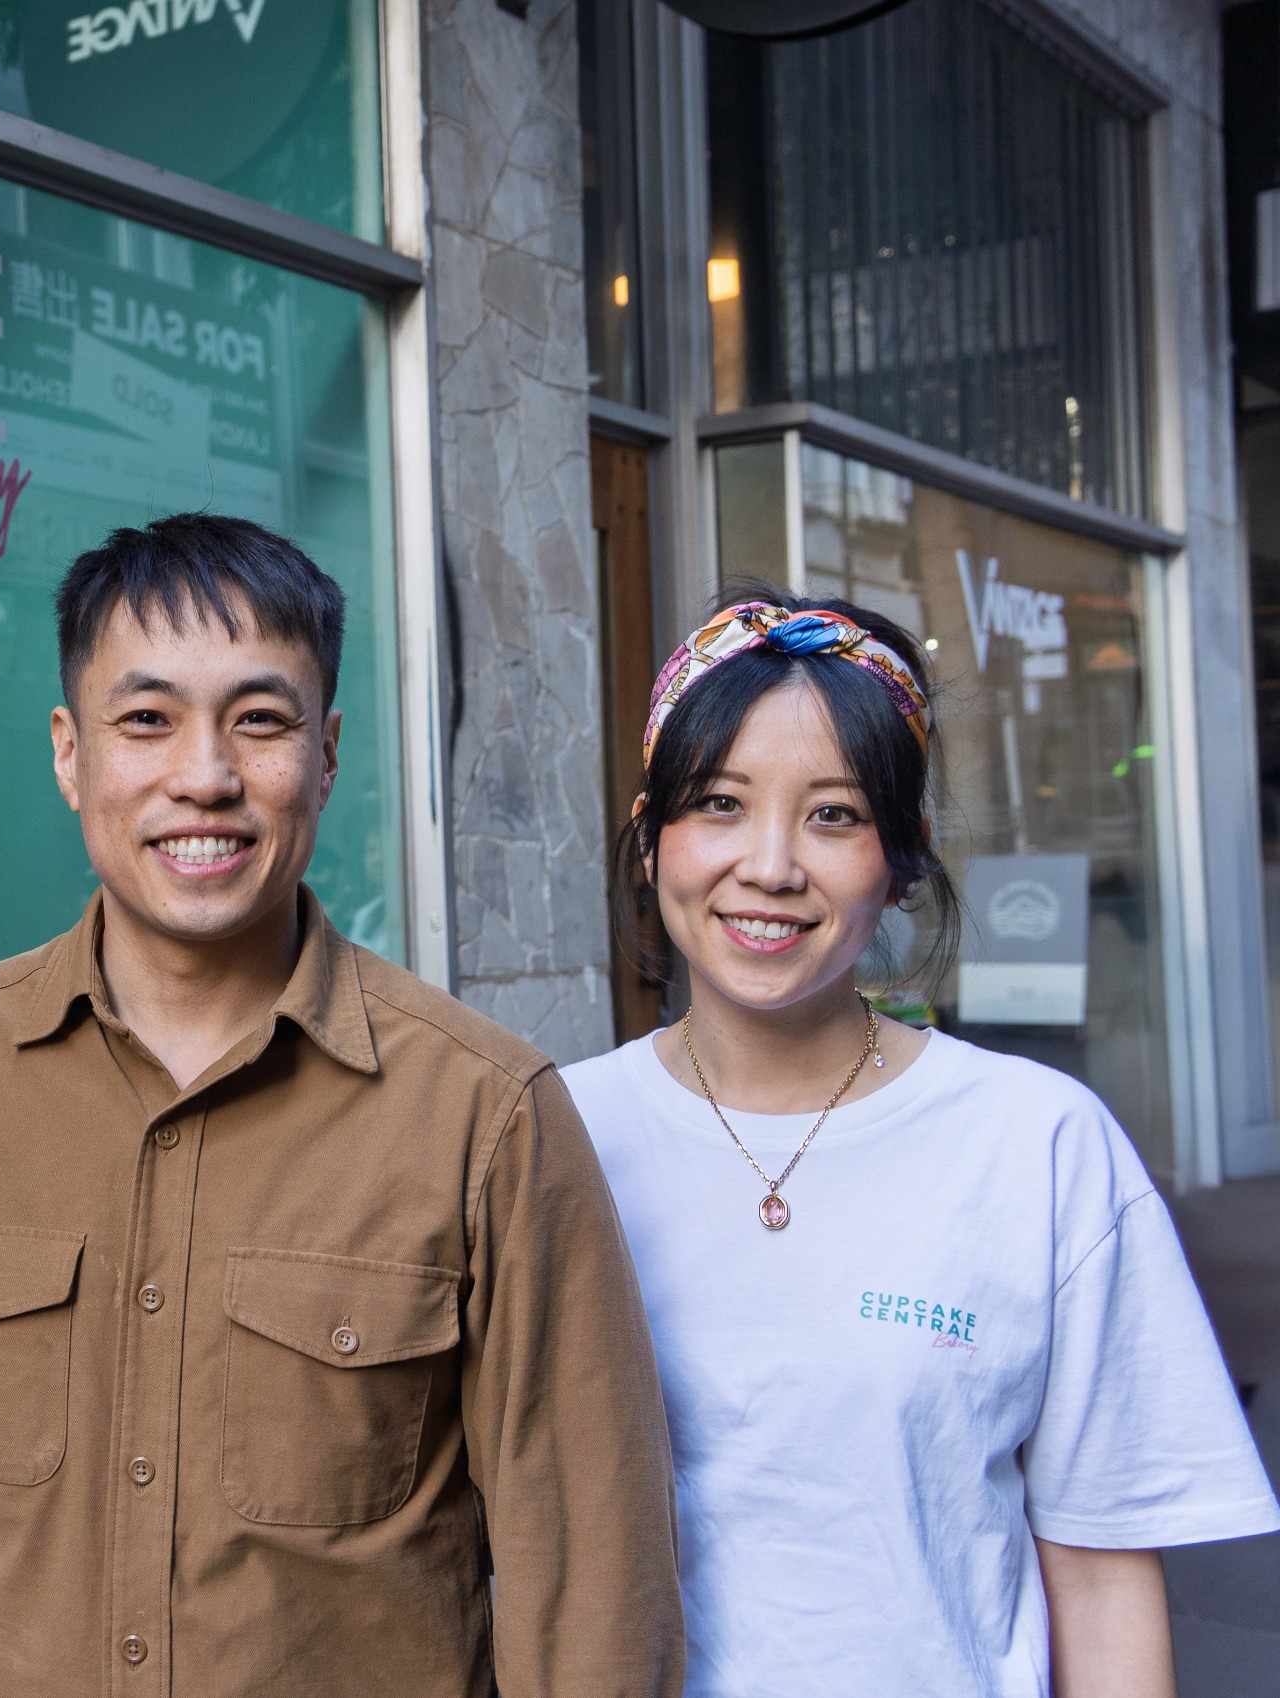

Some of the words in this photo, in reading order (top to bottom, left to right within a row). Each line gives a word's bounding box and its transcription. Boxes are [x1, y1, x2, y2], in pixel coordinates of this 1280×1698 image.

[860, 1305, 974, 1343] CENTRAL
[861, 1291, 977, 1328] CUPCAKE
[931, 1331, 980, 1360] Bakery
